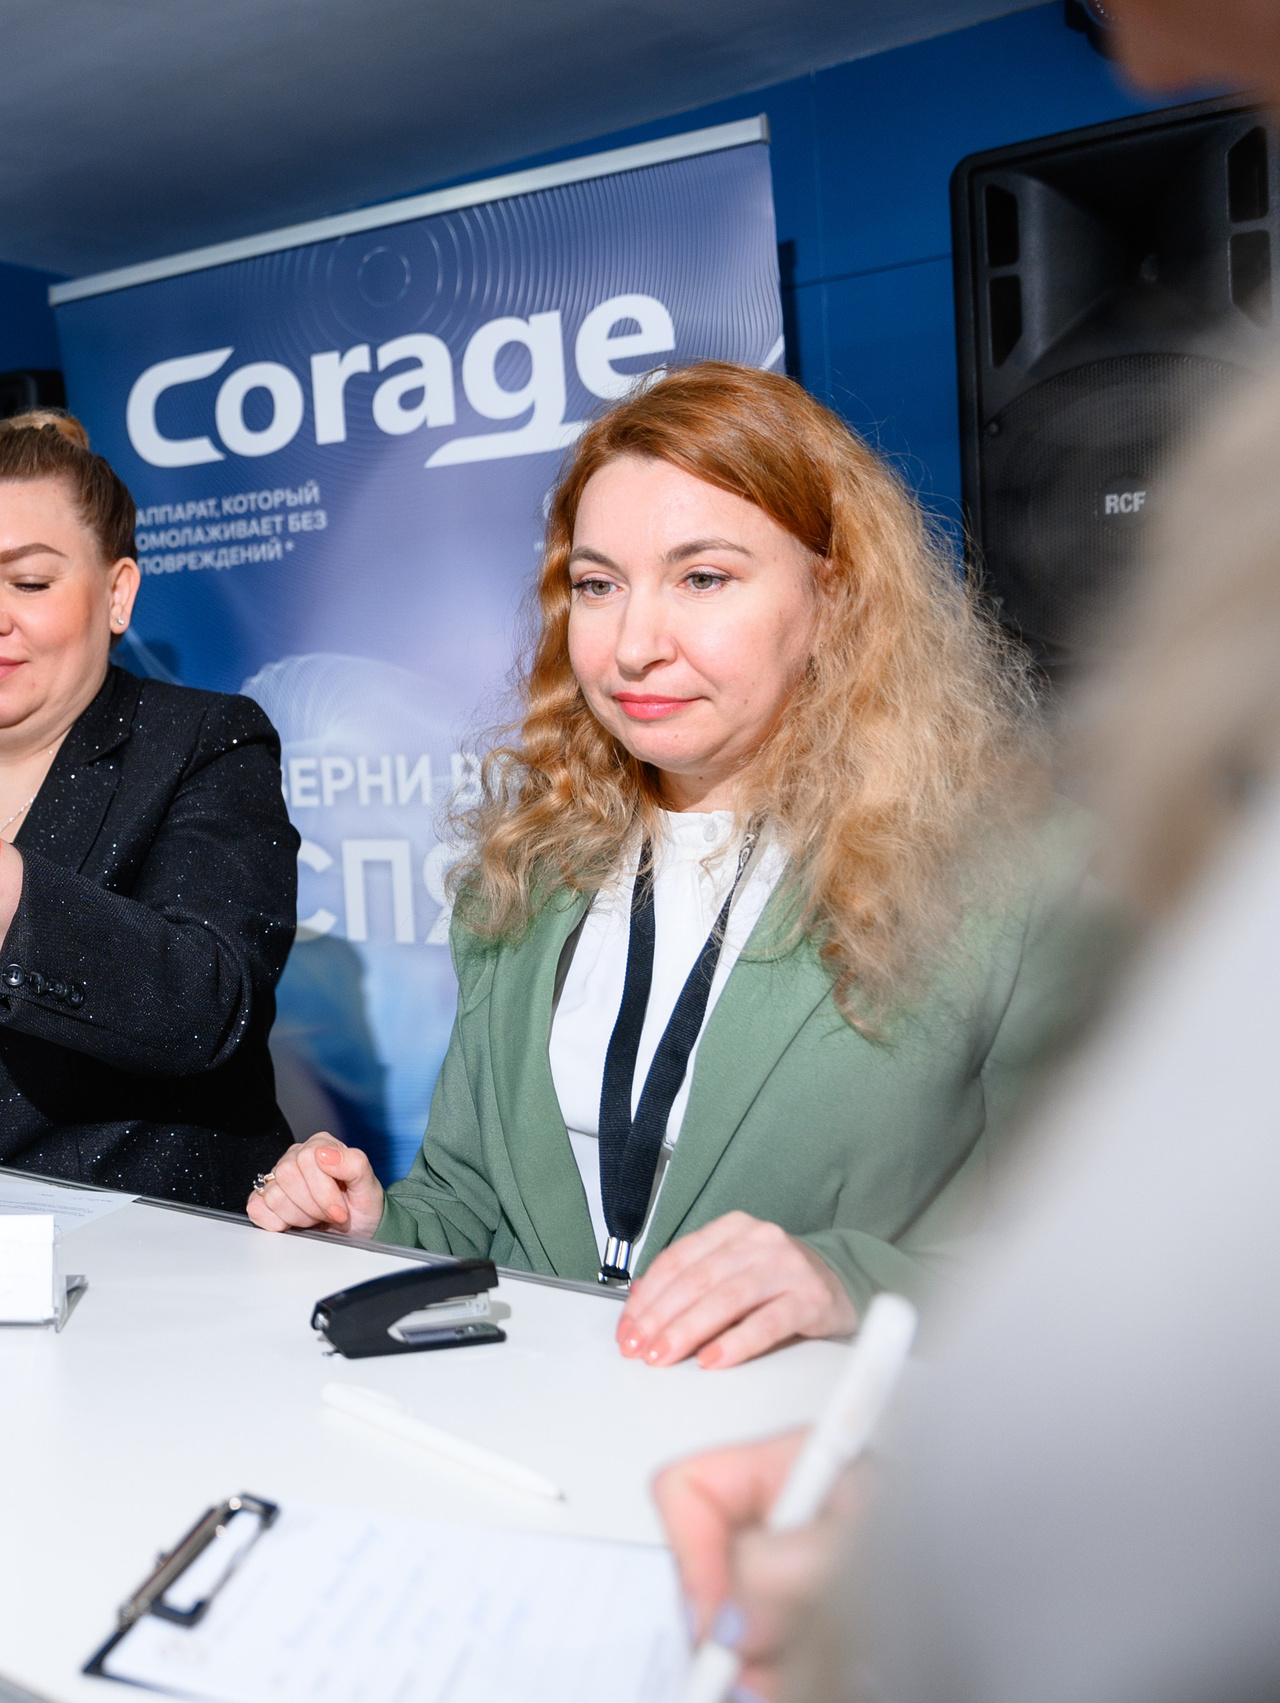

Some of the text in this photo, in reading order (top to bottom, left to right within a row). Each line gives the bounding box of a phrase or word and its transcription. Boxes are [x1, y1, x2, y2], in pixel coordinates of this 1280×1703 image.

[125, 293, 677, 468] Corage
[222, 480, 320, 516] КОТОРЫЙ
[1105, 491, 1146, 514] RCF
[135, 510, 328, 552] ОМОЛАЖИВАЕТ БЕЗ
[281, 753, 433, 808] ЕРНИ
